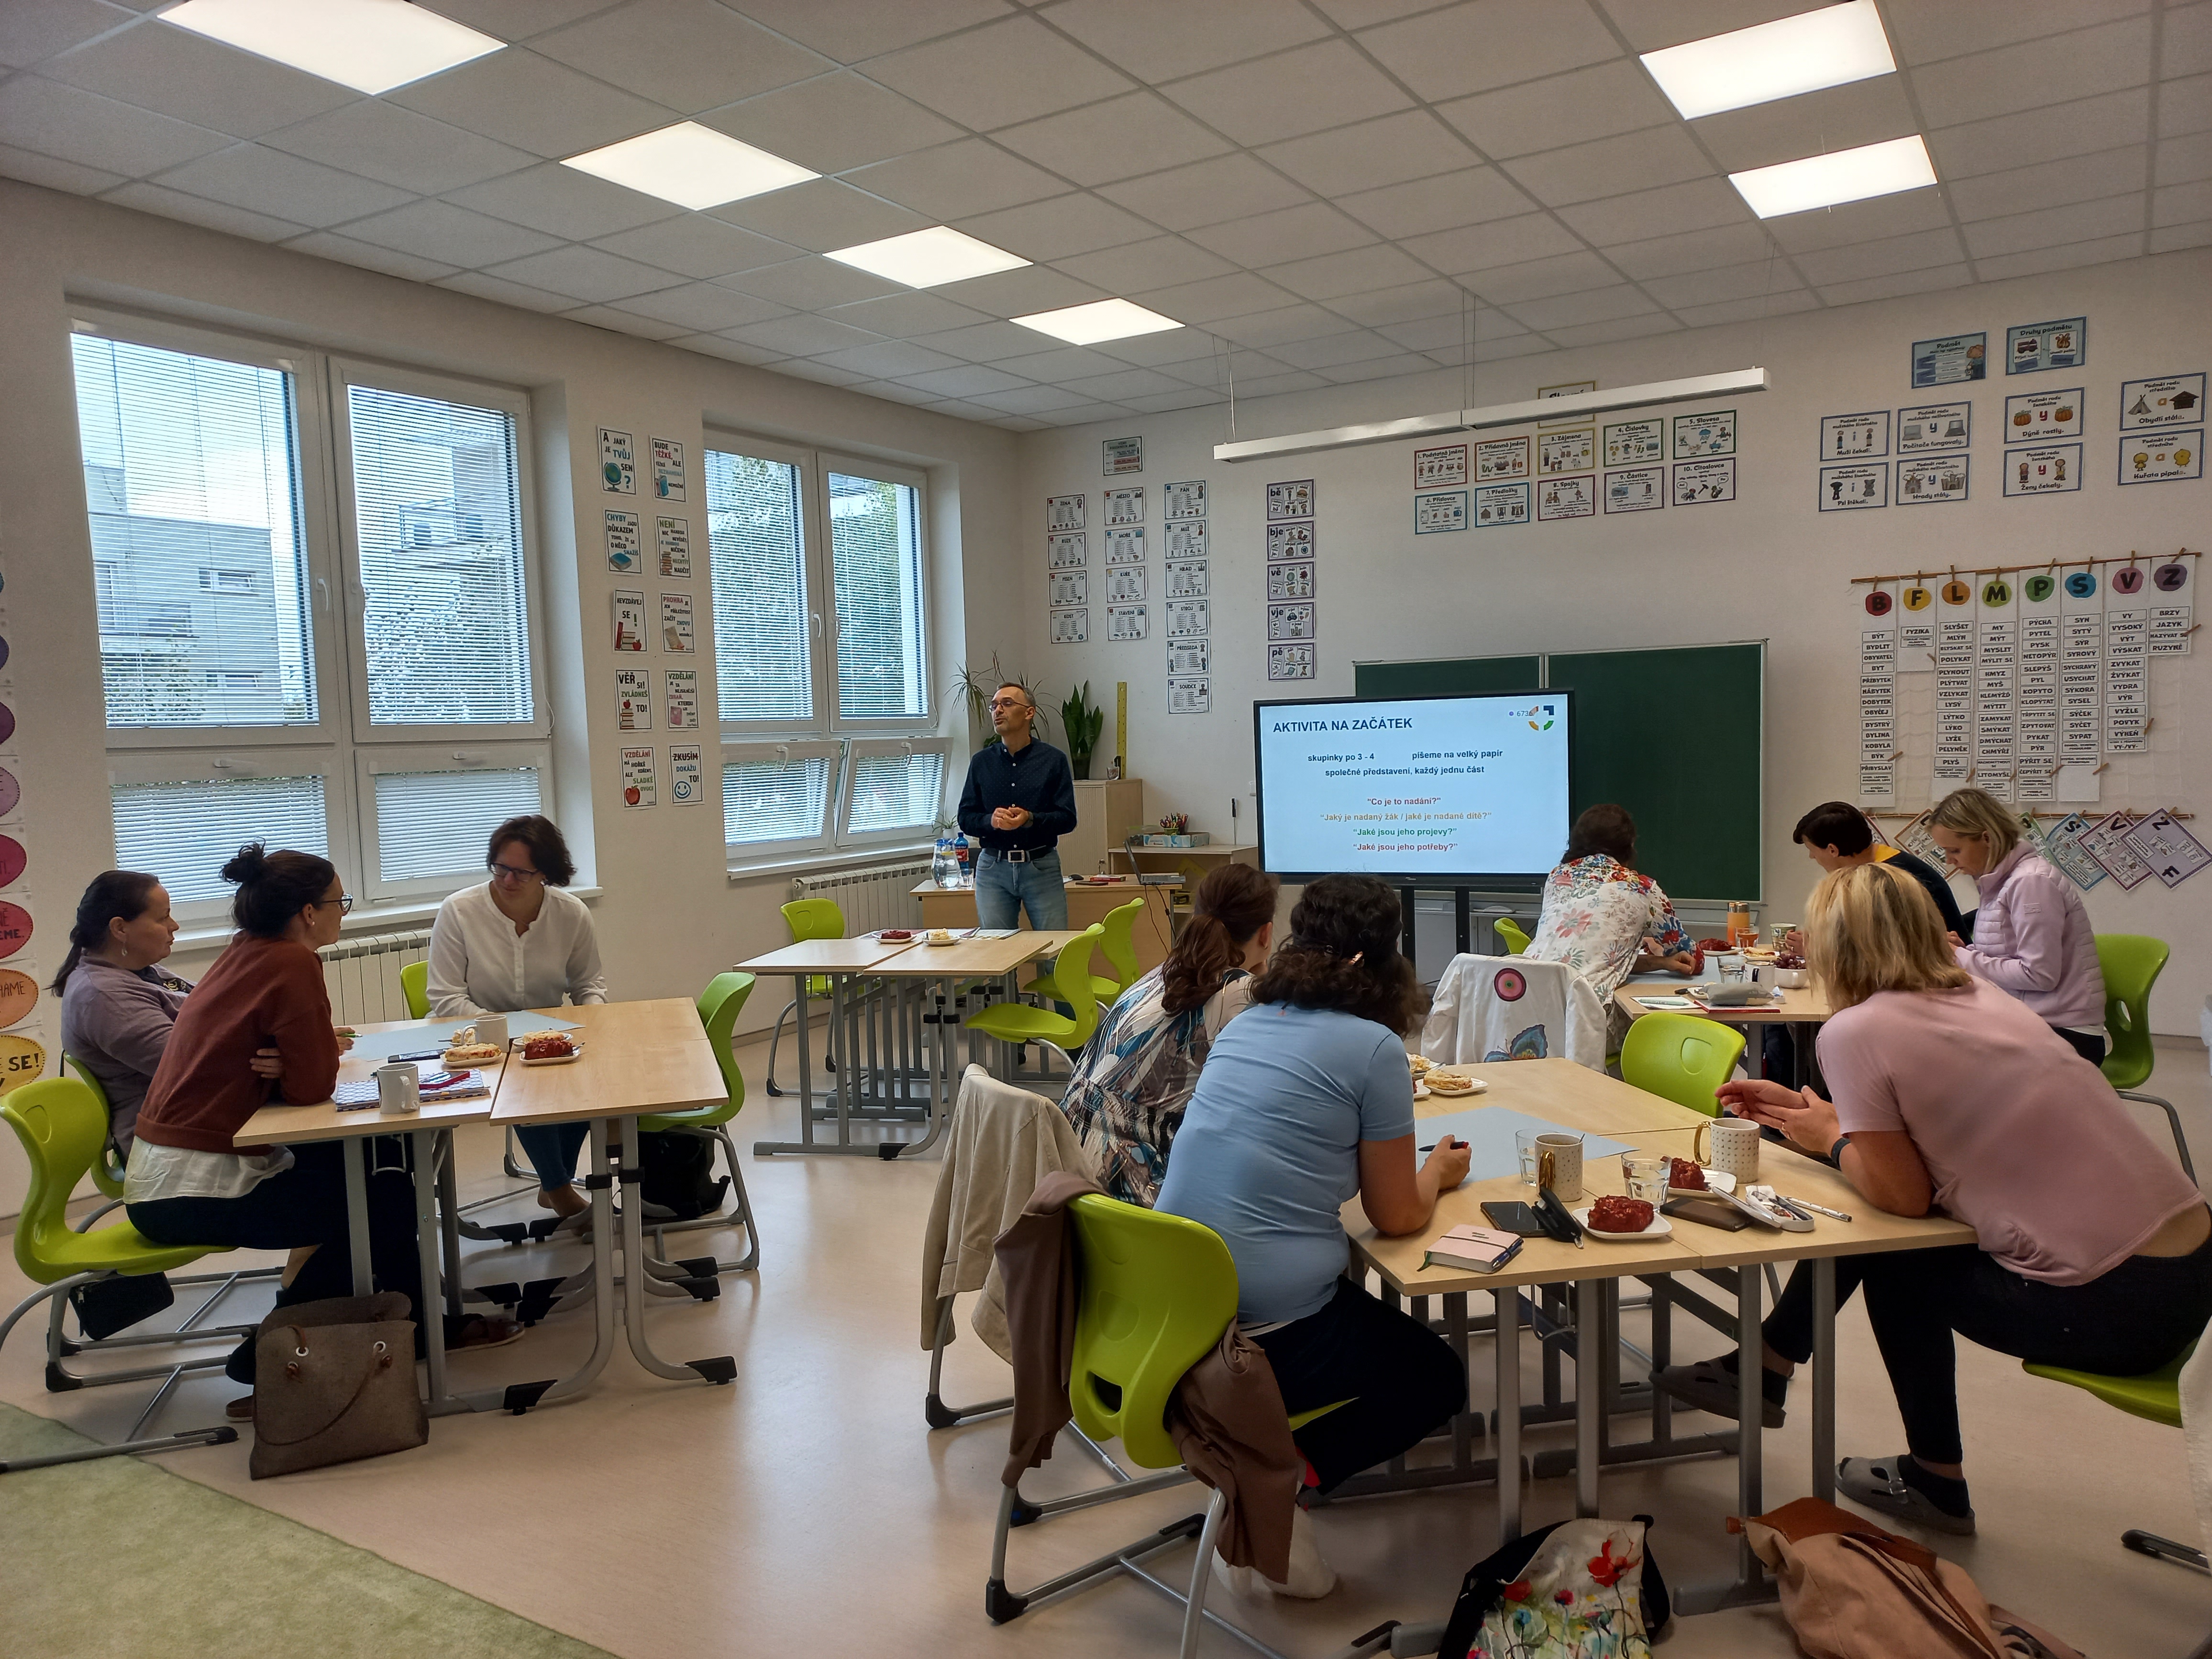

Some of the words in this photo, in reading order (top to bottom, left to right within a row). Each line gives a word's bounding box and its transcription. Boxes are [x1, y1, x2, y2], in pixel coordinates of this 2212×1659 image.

[2020, 329, 2041, 337] Druhy
[1936, 341, 1960, 349] Podmět
[603, 432, 609, 442] A
[654, 441, 669, 450] BUDE
[613, 448, 630, 460] TVŮJ
[621, 463, 633, 472] SEN
[1270, 488, 1281, 497] bě
[607, 513, 626, 522] CHYBY
[608, 524, 633, 534] DŮKAZEM
[1270, 528, 1283, 538] bje
[1271, 566, 1282, 576] vě
[2120, 572, 2136, 589] V
[2163, 568, 2180, 586] Z
[2034, 579, 2048, 596] P
[2072, 576, 2089, 594] S
[1912, 590, 1923, 606] F
[1952, 586, 1963, 601] L
[1986, 585, 2007, 602] M
[1872, 596, 1887, 611] B
[622, 610, 630, 619] SE
[1271, 608, 1283, 619] vje
[1272, 648, 1283, 658] pě
[2067, 649, 2096, 657] SYROVÝ
[618, 672, 635, 684] VĚŘ
[621, 689, 648, 697] ZVLÁDNEŠ
[636, 704, 647, 712] TO!
[1273, 721, 1327, 732] AKTIVITA
[1331, 720, 1349, 730] NA
[1352, 716, 1413, 730] ZAČÁTEK
[624, 750, 651, 758] VZDĚLÁNÍ
[672, 751, 698, 761] ZKUSÍM
[1308, 754, 1343, 763] skupinky
[1412, 751, 1441, 760] píšeme
[1457, 750, 1479, 759] velký
[1481, 749, 1503, 759] papír
[676, 764, 697, 772] DOKÁŽU
[1325, 768, 1361, 777] společné
[1363, 767, 1412, 776] představení,
[1415, 766, 1438, 775] každý
[1440, 767, 1464, 775] jednu
[633, 775, 653, 784] SLADKÉ
[688, 774, 699, 783] TO!
[1384, 798, 1391, 807] je
[1397, 829, 1415, 837] jeho
[1397, 843, 1415, 852] jeho
[8, 1053, 40, 1072] SE!
